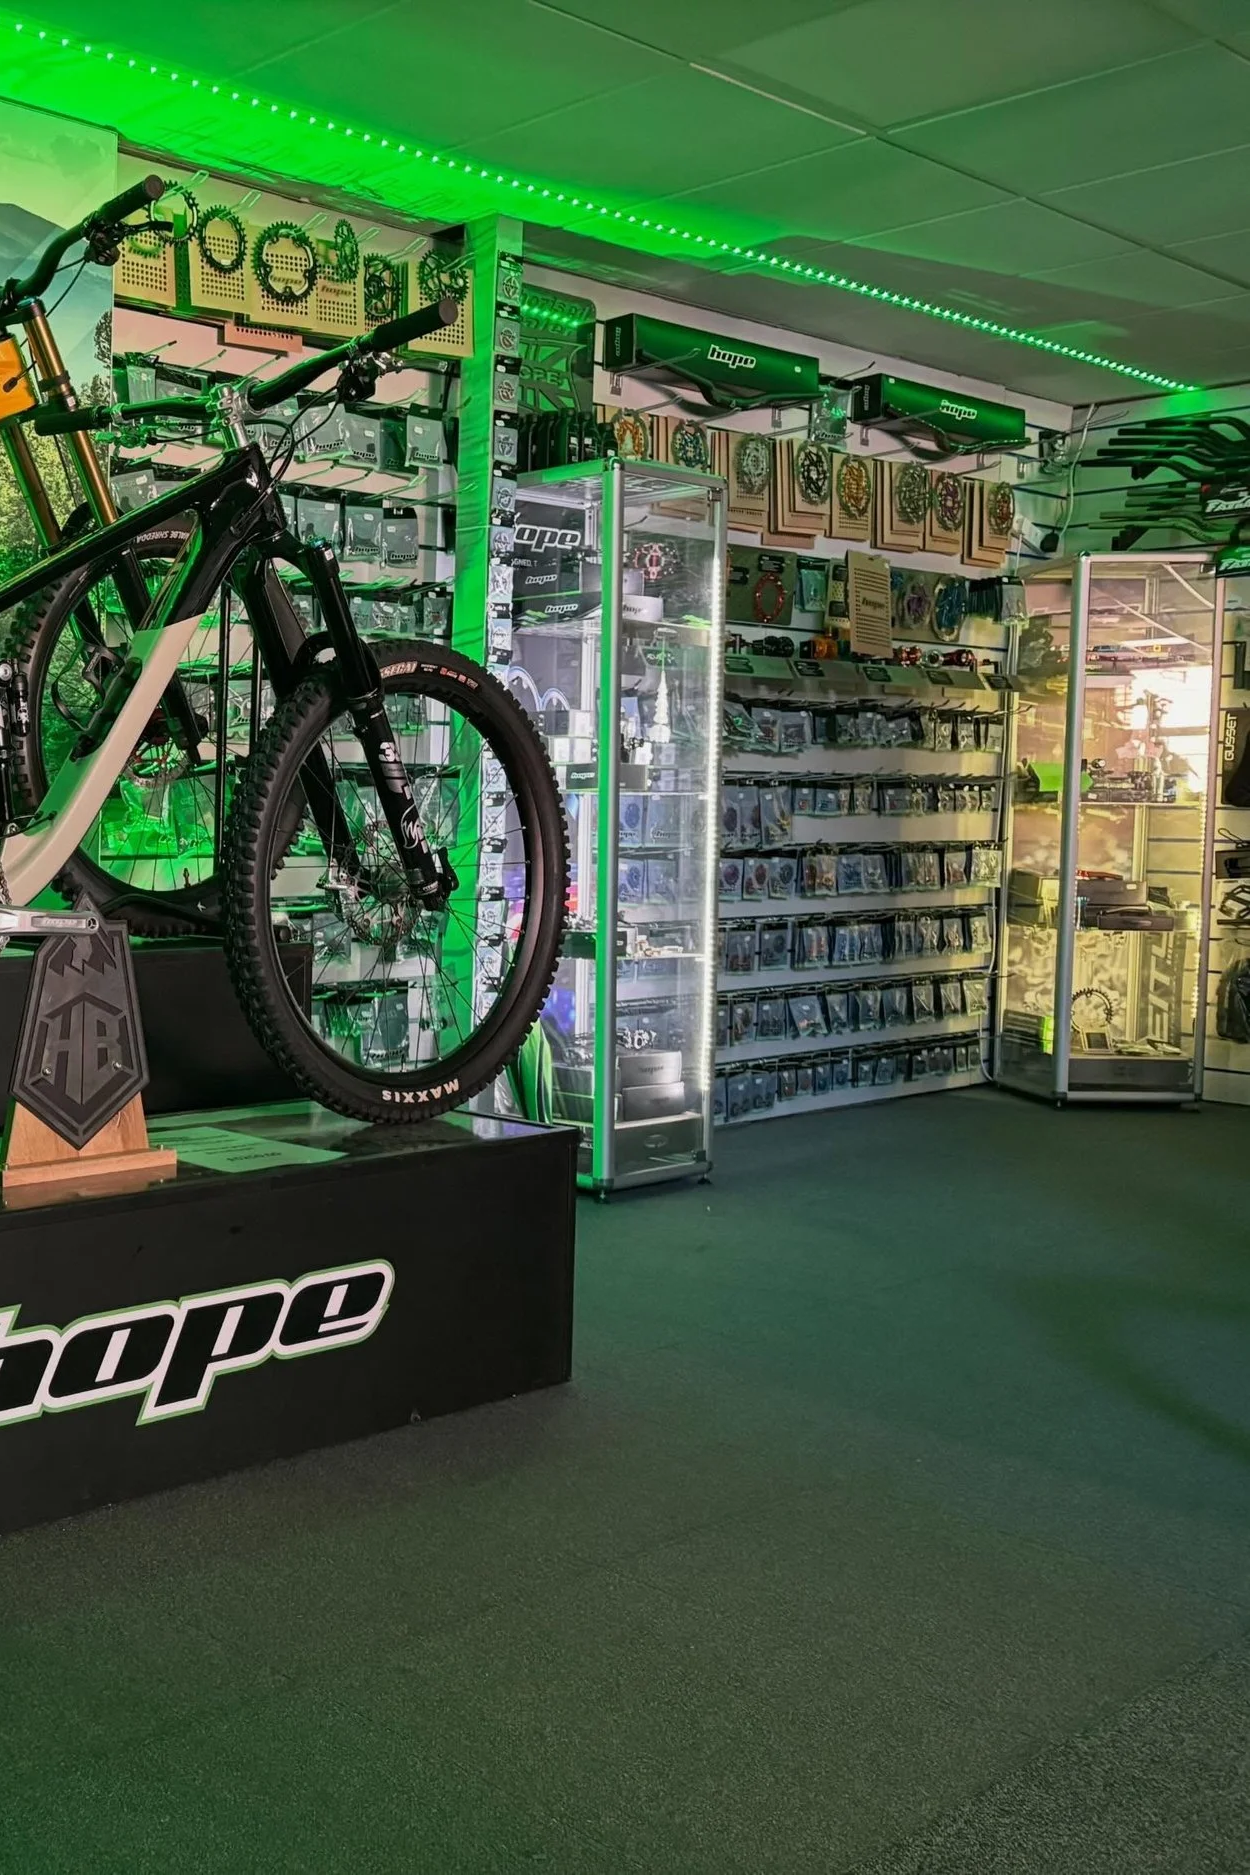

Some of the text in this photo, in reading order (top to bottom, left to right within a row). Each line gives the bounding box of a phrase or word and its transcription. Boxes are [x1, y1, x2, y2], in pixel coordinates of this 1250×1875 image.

[707, 344, 757, 369] hope
[513, 523, 581, 553] ope
[525, 574, 558, 585] hope
[545, 603, 579, 613] hope
[1224, 713, 1237, 761] GUSSET
[381, 1078, 460, 1103] MAXXIS
